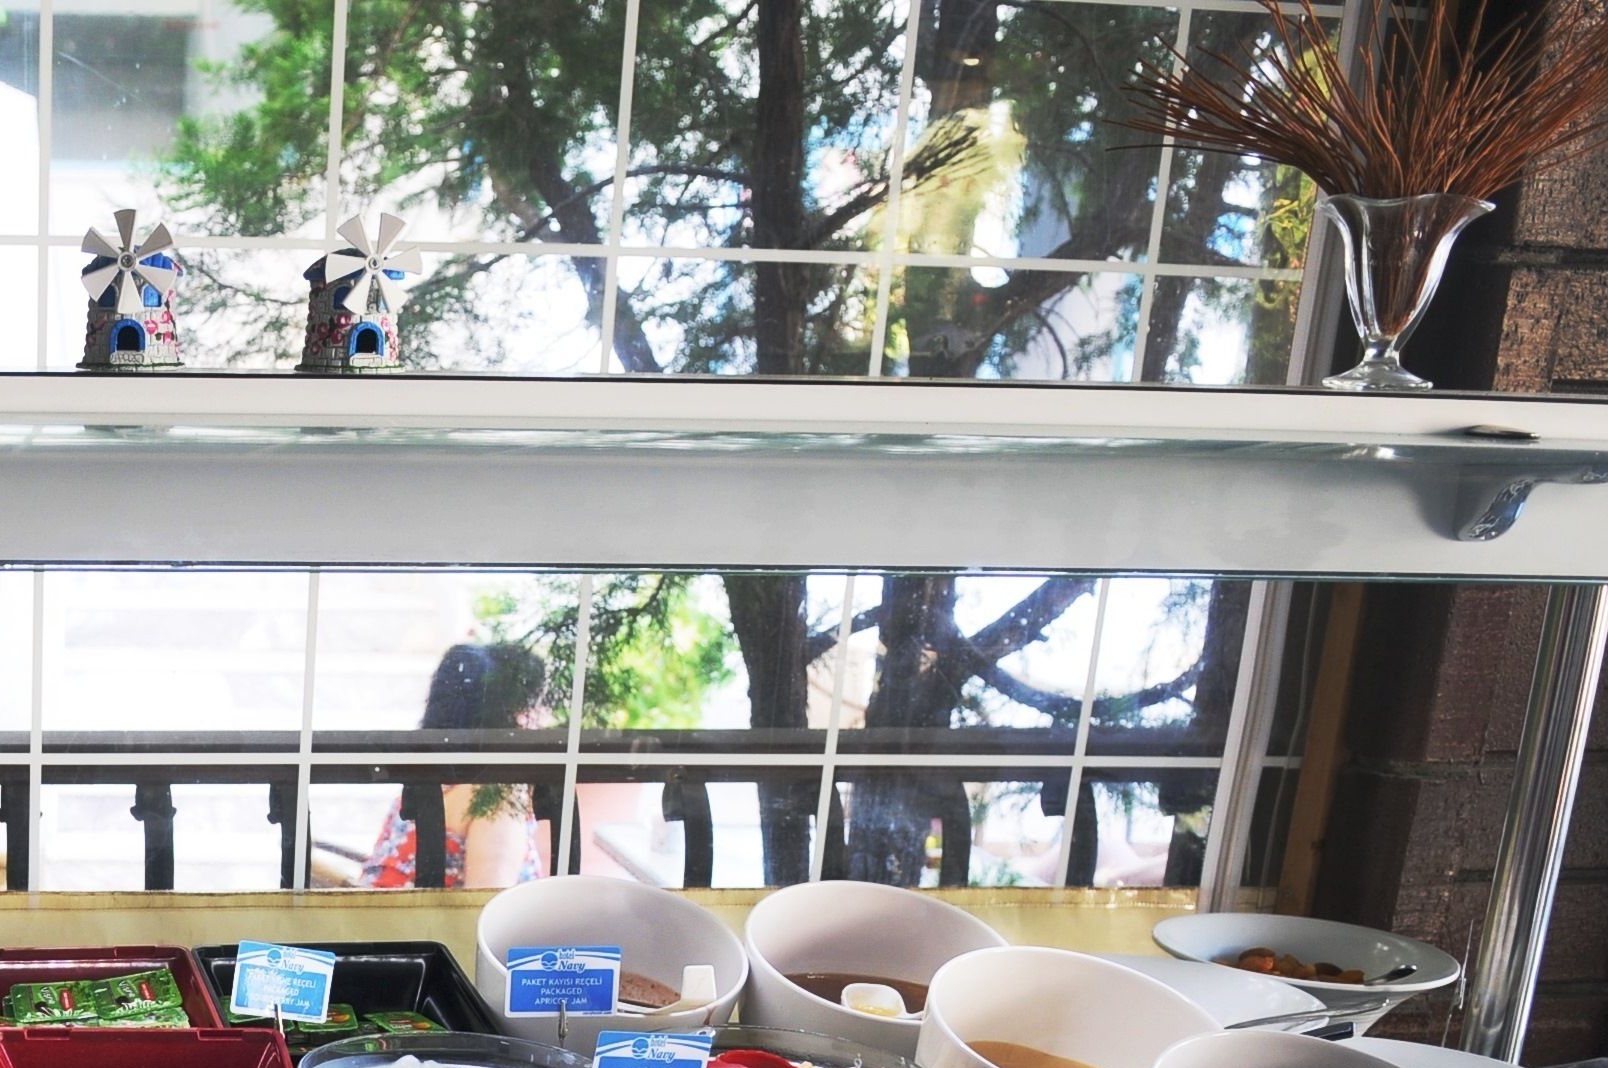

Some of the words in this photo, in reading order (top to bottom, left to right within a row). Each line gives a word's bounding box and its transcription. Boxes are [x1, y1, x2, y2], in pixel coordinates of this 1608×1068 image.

[558, 960, 586, 974] Navy
[521, 978, 546, 986] PAKET
[540, 987, 583, 995] PACKAGED
[571, 997, 588, 1005] JAM
[647, 1048, 676, 1063] Navy
